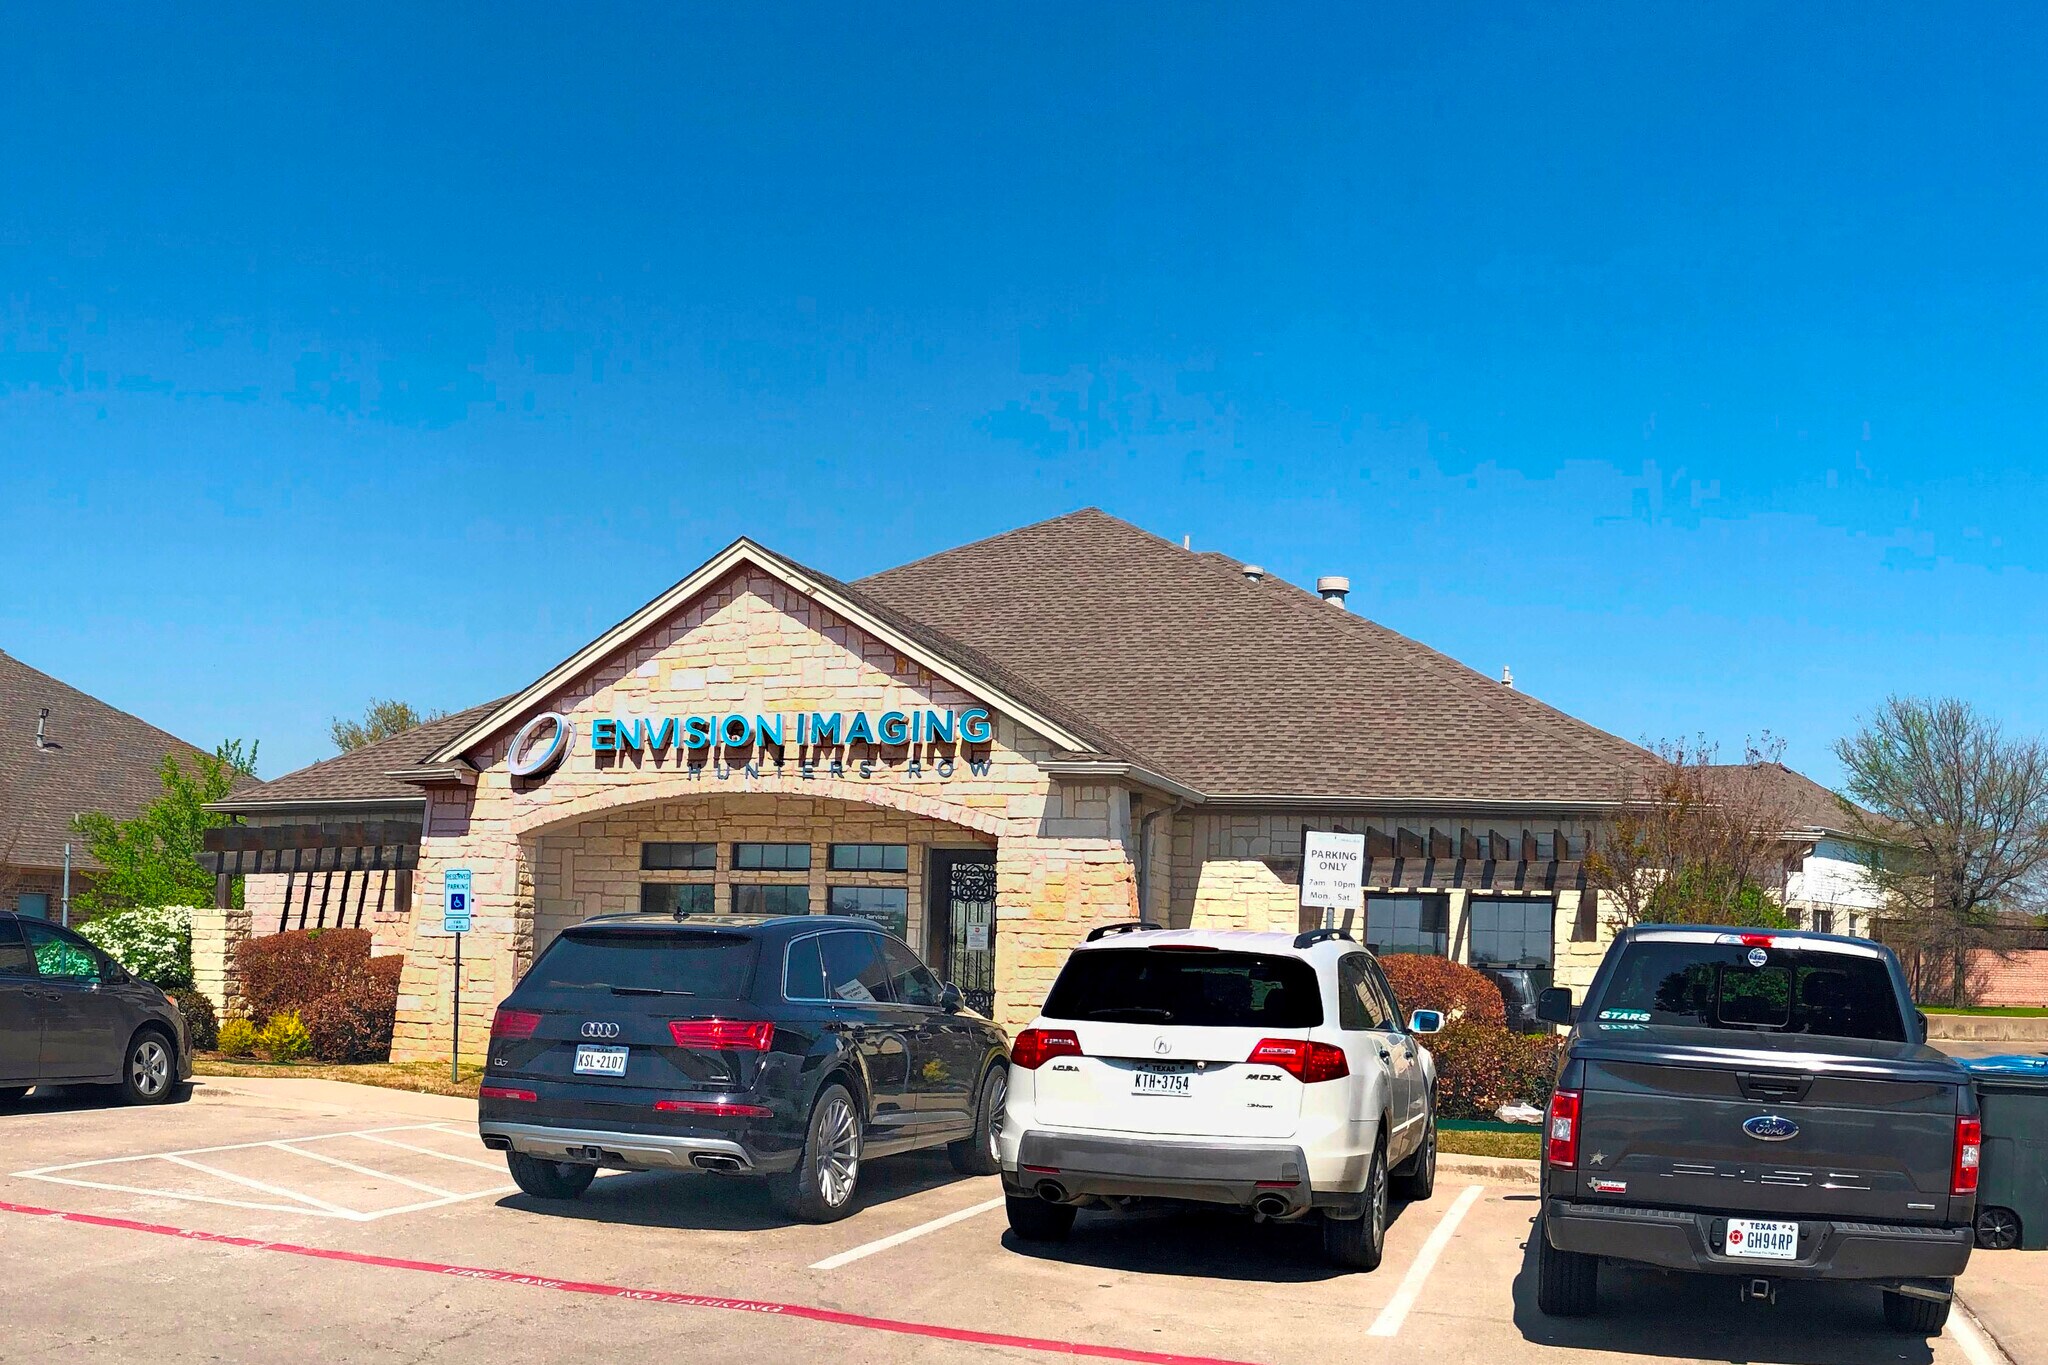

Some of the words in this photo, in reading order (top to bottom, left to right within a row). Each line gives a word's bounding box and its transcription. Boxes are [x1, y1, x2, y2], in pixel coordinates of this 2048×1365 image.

[590, 713, 784, 750] ENVISION
[796, 707, 992, 746] IMAGING
[687, 761, 872, 781] HUNTERS
[908, 758, 992, 779] ROW
[1311, 850, 1357, 861] PARKING
[1319, 861, 1347, 871] ONLY
[1309, 878, 1326, 886] 7am
[1333, 880, 1356, 889] 10pm
[1598, 1010, 1652, 1022] STARS
[494, 1057, 509, 1067] Q7
[1052, 1064, 1081, 1073] ACURA
[1245, 1073, 1283, 1082] MDX
[1749, 1222, 1778, 1231] TEXAS
[1747, 1231, 1793, 1251] GH94RP
[617, 1290, 659, 1300] NO
[662, 1296, 784, 1312] PARKING
